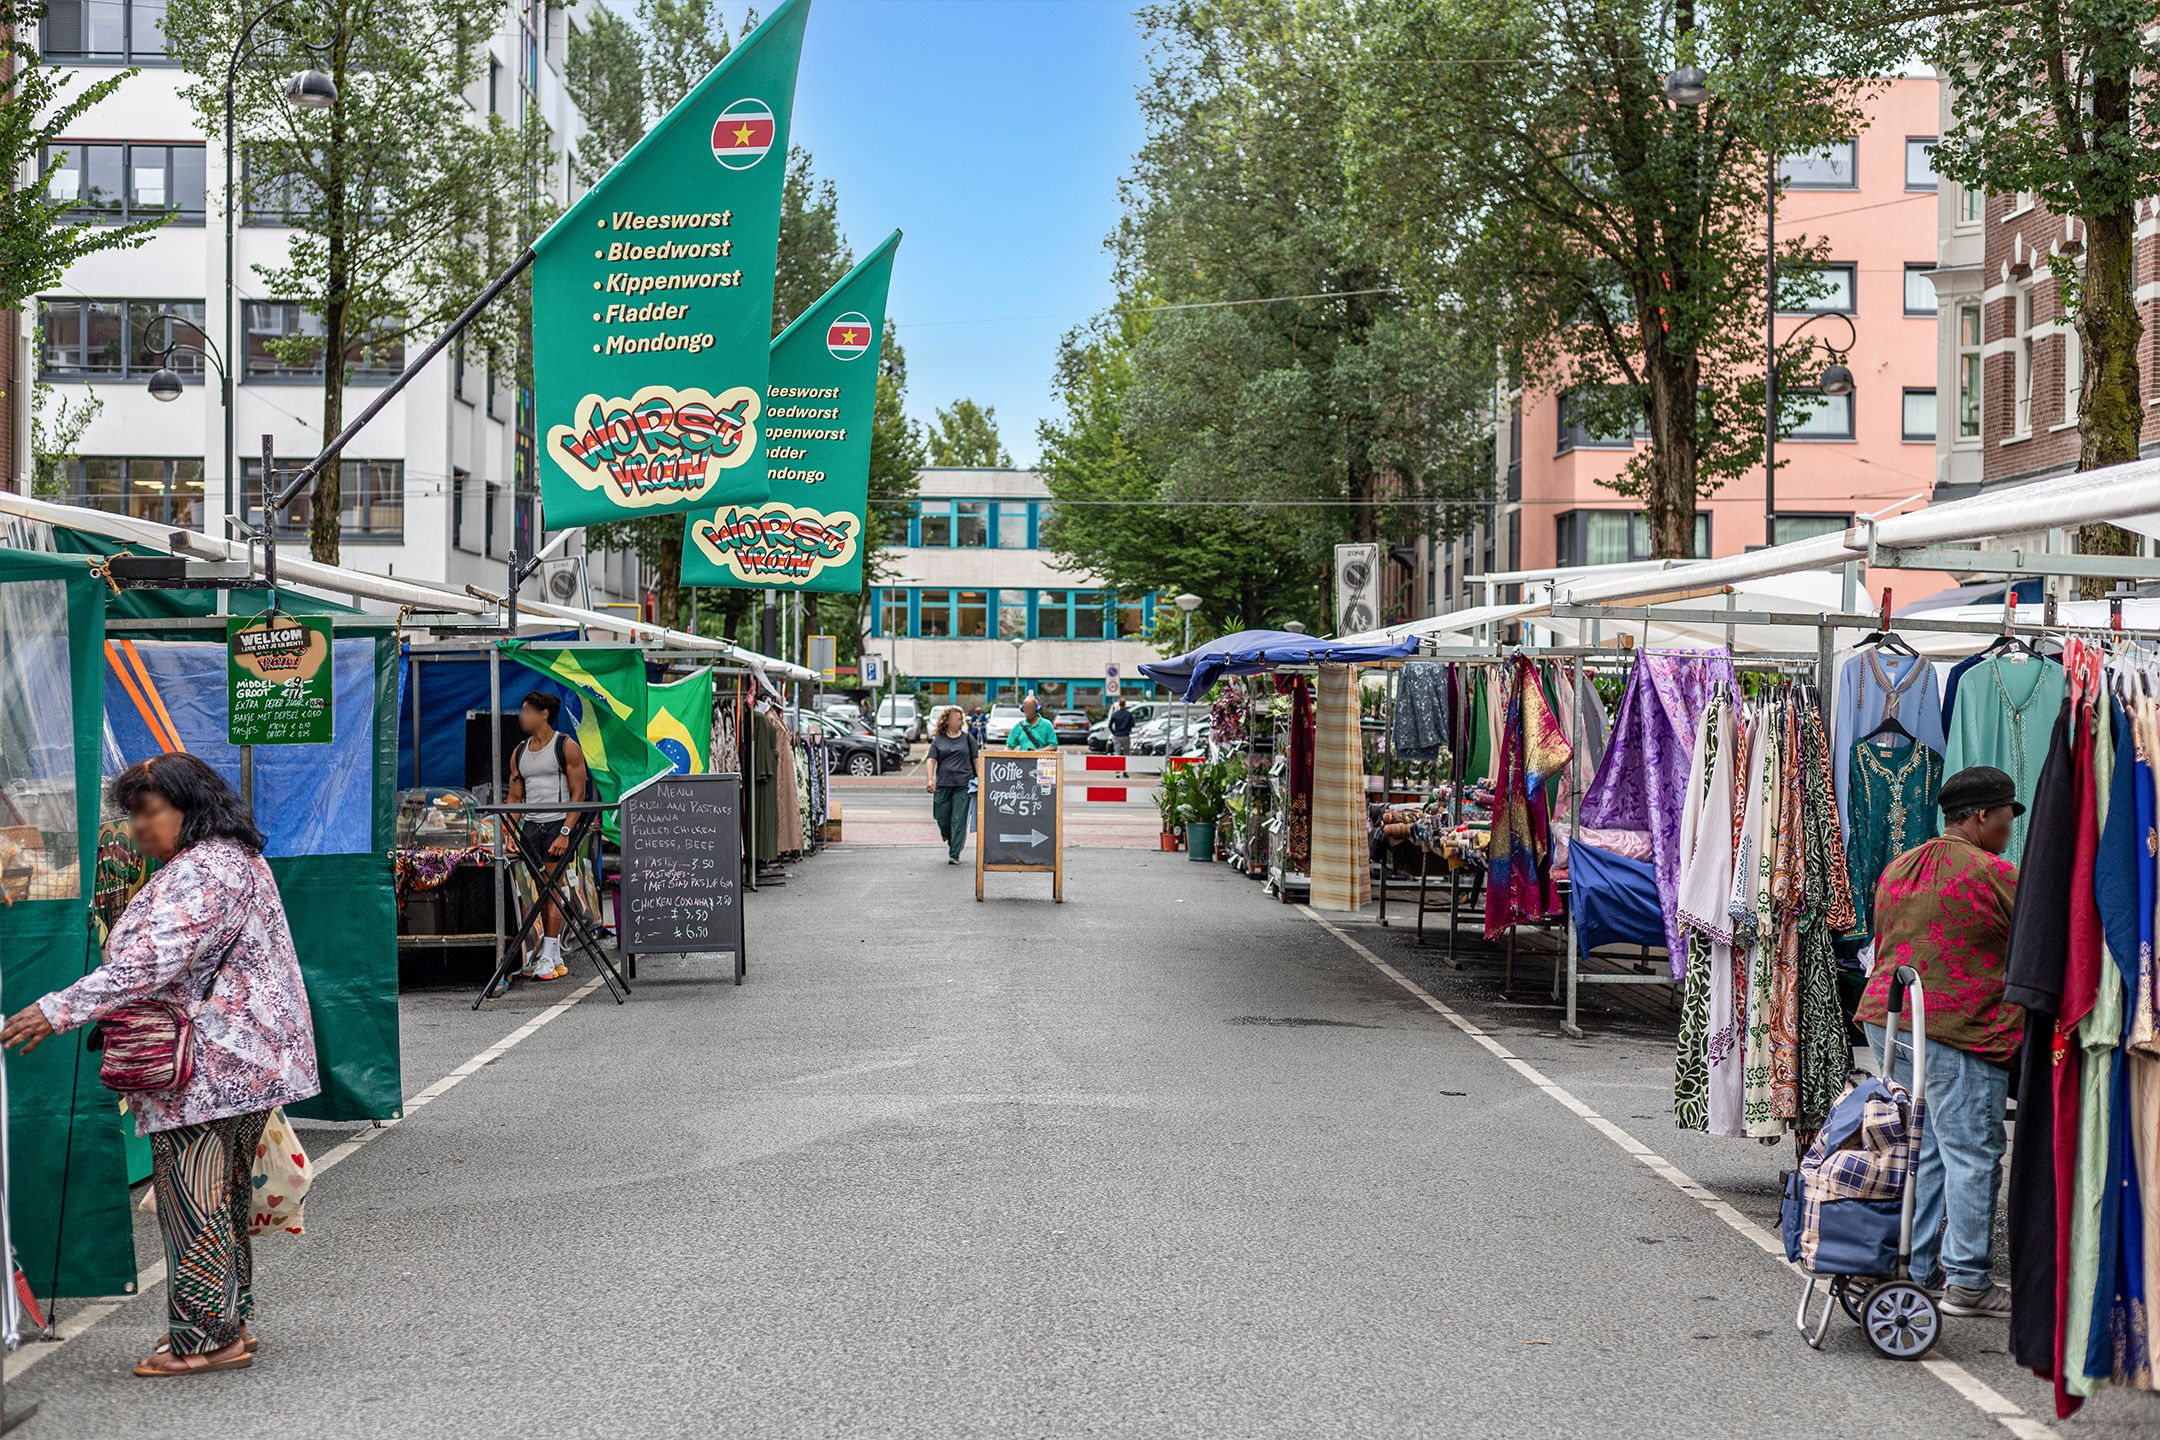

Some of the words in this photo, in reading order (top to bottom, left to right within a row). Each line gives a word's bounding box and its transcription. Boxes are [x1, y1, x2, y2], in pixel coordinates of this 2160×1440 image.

[612, 210, 733, 231] Vleesworst
[607, 240, 733, 261] Bloedworst
[606, 269, 743, 296] Kippenworst
[605, 301, 690, 324] Fladder
[605, 332, 716, 355] Mondongo
[767, 384, 841, 399] leesworst
[766, 404, 839, 420] oedworst
[766, 427, 848, 440] ppenworst
[766, 446, 808, 460] dder
[607, 447, 711, 498] VROUW
[767, 467, 827, 484] ndongo
[735, 548, 818, 577] VROUW
[240, 629, 303, 647] WELKOM
[236, 688, 271, 699] GROOT
[234, 700, 259, 711] EXTRA
[990, 762, 1023, 783] Koffie
[1016, 780, 1024, 789] &
[690, 801, 732, 815] PASTRIES
[630, 813, 679, 825] BANANA
[673, 825, 716, 835] CHICKEN
[685, 840, 715, 851] BEEF
[630, 873, 639, 883] 2
[631, 897, 673, 913] CHICKEN
